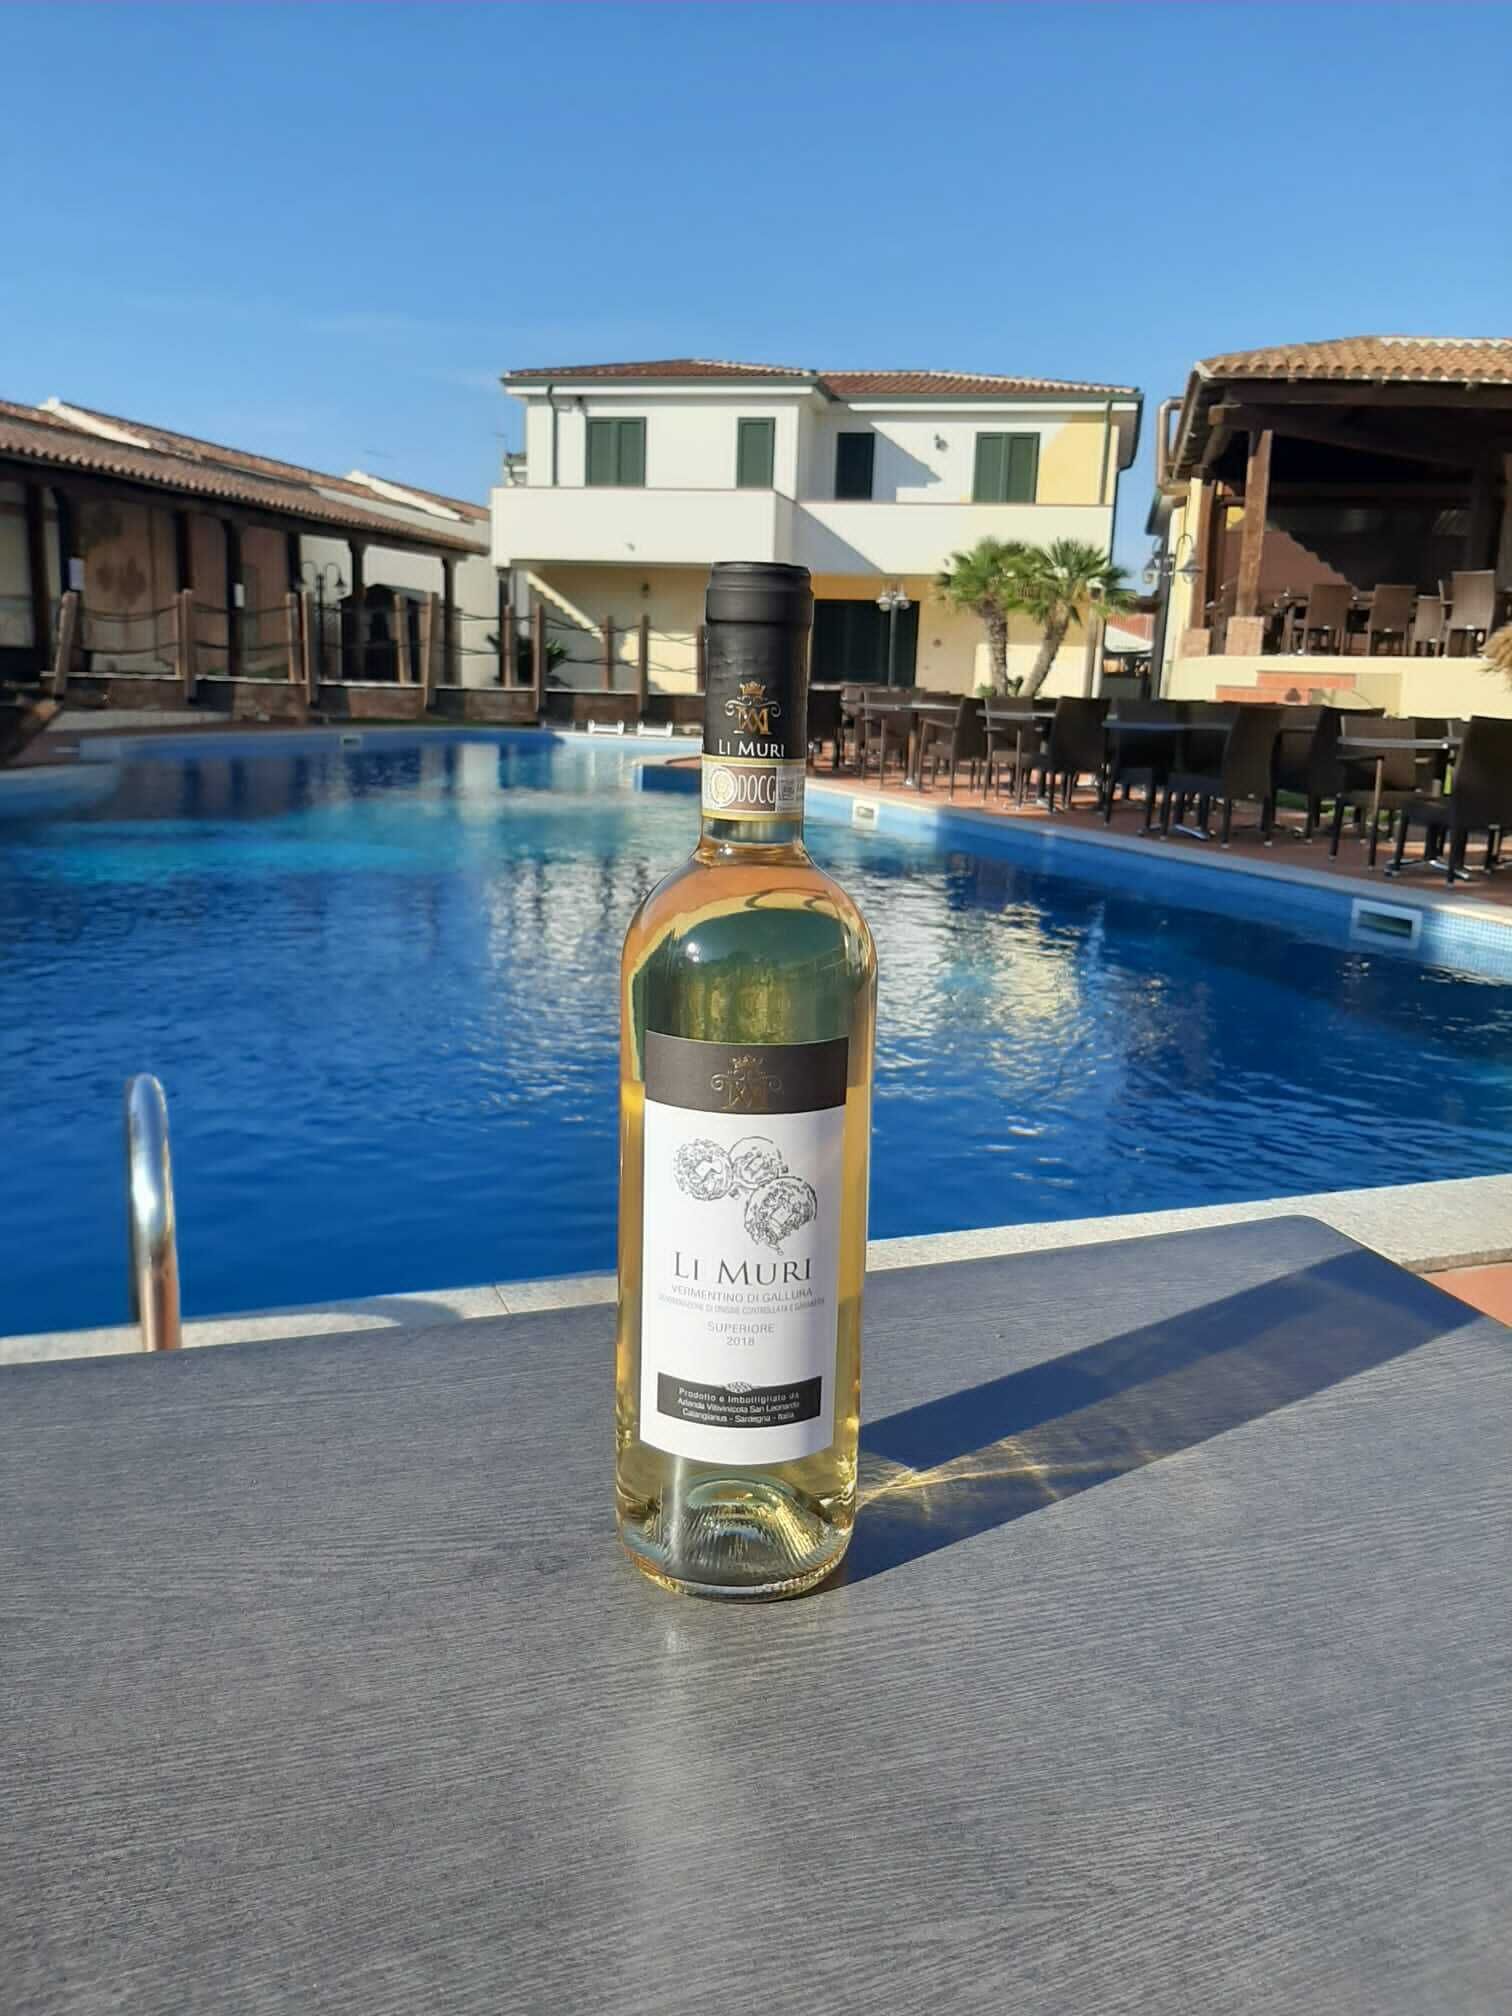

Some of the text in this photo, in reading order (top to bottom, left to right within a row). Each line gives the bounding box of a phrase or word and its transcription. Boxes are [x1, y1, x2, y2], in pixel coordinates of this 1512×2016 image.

[738, 741, 785, 758] MURI
[737, 774, 776, 804] DOCG
[718, 1257, 811, 1286] MURI
[671, 1284, 813, 1304] VERMENTINO DI GALLURA
[707, 1321, 775, 1335] SUPERIORE
[726, 1336, 755, 1347] 2018
[678, 1387, 717, 1403] Prodotto
[750, 1405, 766, 1414] San
